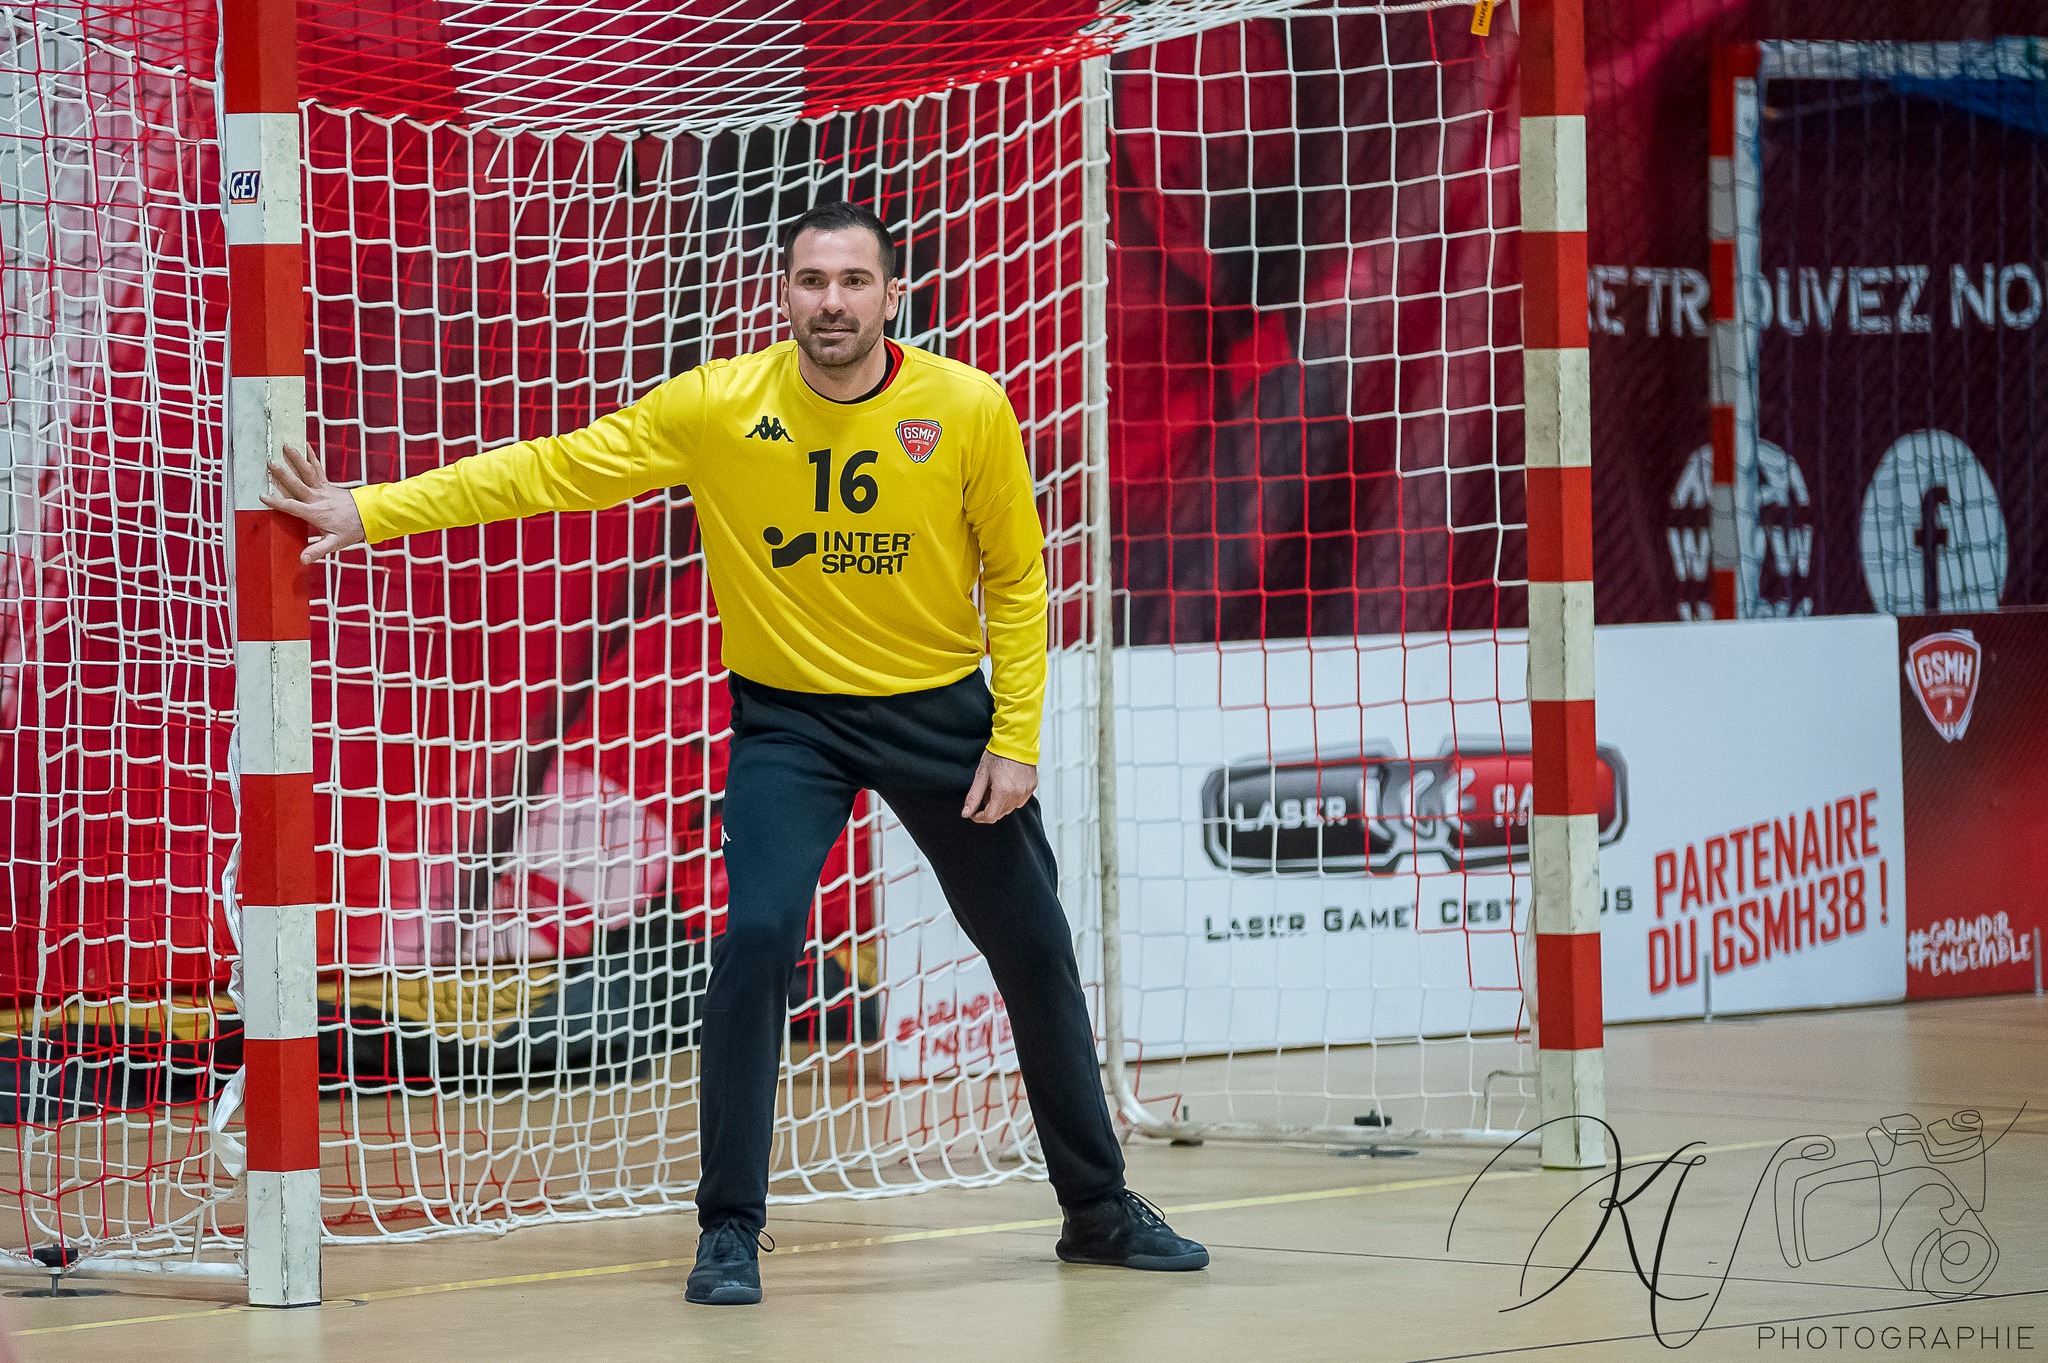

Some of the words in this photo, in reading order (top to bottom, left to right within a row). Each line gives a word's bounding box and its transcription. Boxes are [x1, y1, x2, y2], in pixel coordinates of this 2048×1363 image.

[231, 172, 258, 199] GES
[904, 426, 937, 442] GSMH
[808, 448, 879, 514] 16
[823, 531, 910, 553] INTER
[821, 553, 908, 575] SPORT
[1918, 649, 1973, 689] GSMH
[1235, 796, 1348, 832] LASER
[1655, 789, 1879, 919] PARTENAIRE
[1206, 914, 1306, 940] LASER
[1648, 917, 1697, 995] DU
[1712, 867, 1867, 976] GSMH38
[1930, 932, 2031, 977] ENSEMBLE
